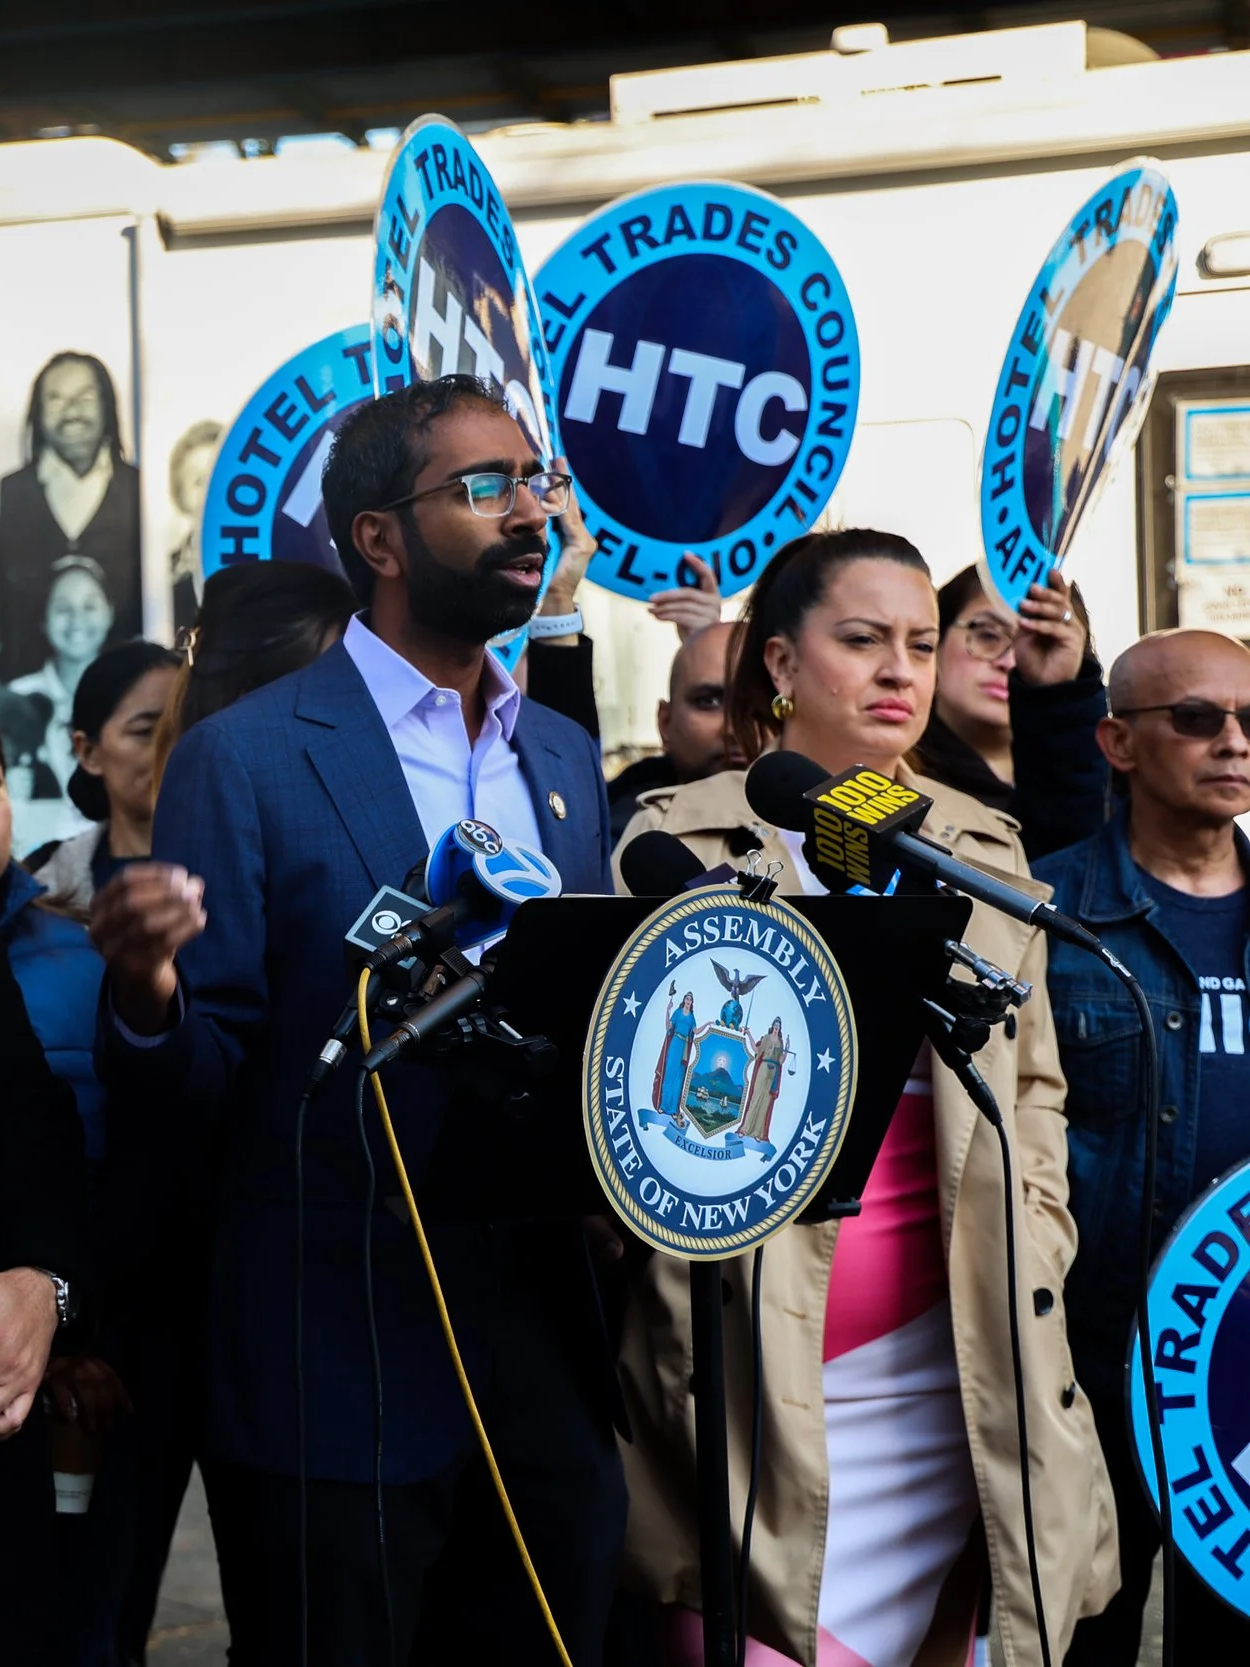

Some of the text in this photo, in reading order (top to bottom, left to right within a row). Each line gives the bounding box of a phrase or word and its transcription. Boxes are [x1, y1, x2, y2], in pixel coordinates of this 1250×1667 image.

[414, 143, 515, 269] TRADES
[563, 327, 809, 467] HTC
[581, 203, 799, 275] TRADES
[774, 272, 851, 529] COUNCIL
[990, 285, 1064, 501] HOTEL
[220, 375, 338, 567] HOTEL
[460, 820, 499, 854] abc
[813, 807, 846, 872] 1010
[816, 771, 893, 812] 1010
[845, 784, 920, 826] WINS
[844, 821, 872, 886] WINS
[664, 915, 826, 1008] ASSEMBLY
[605, 1056, 827, 1231] STATE OF NEW YORK
[675, 1135, 733, 1160] EXCELSIOR
[1155, 1203, 1250, 1425] TRAD
